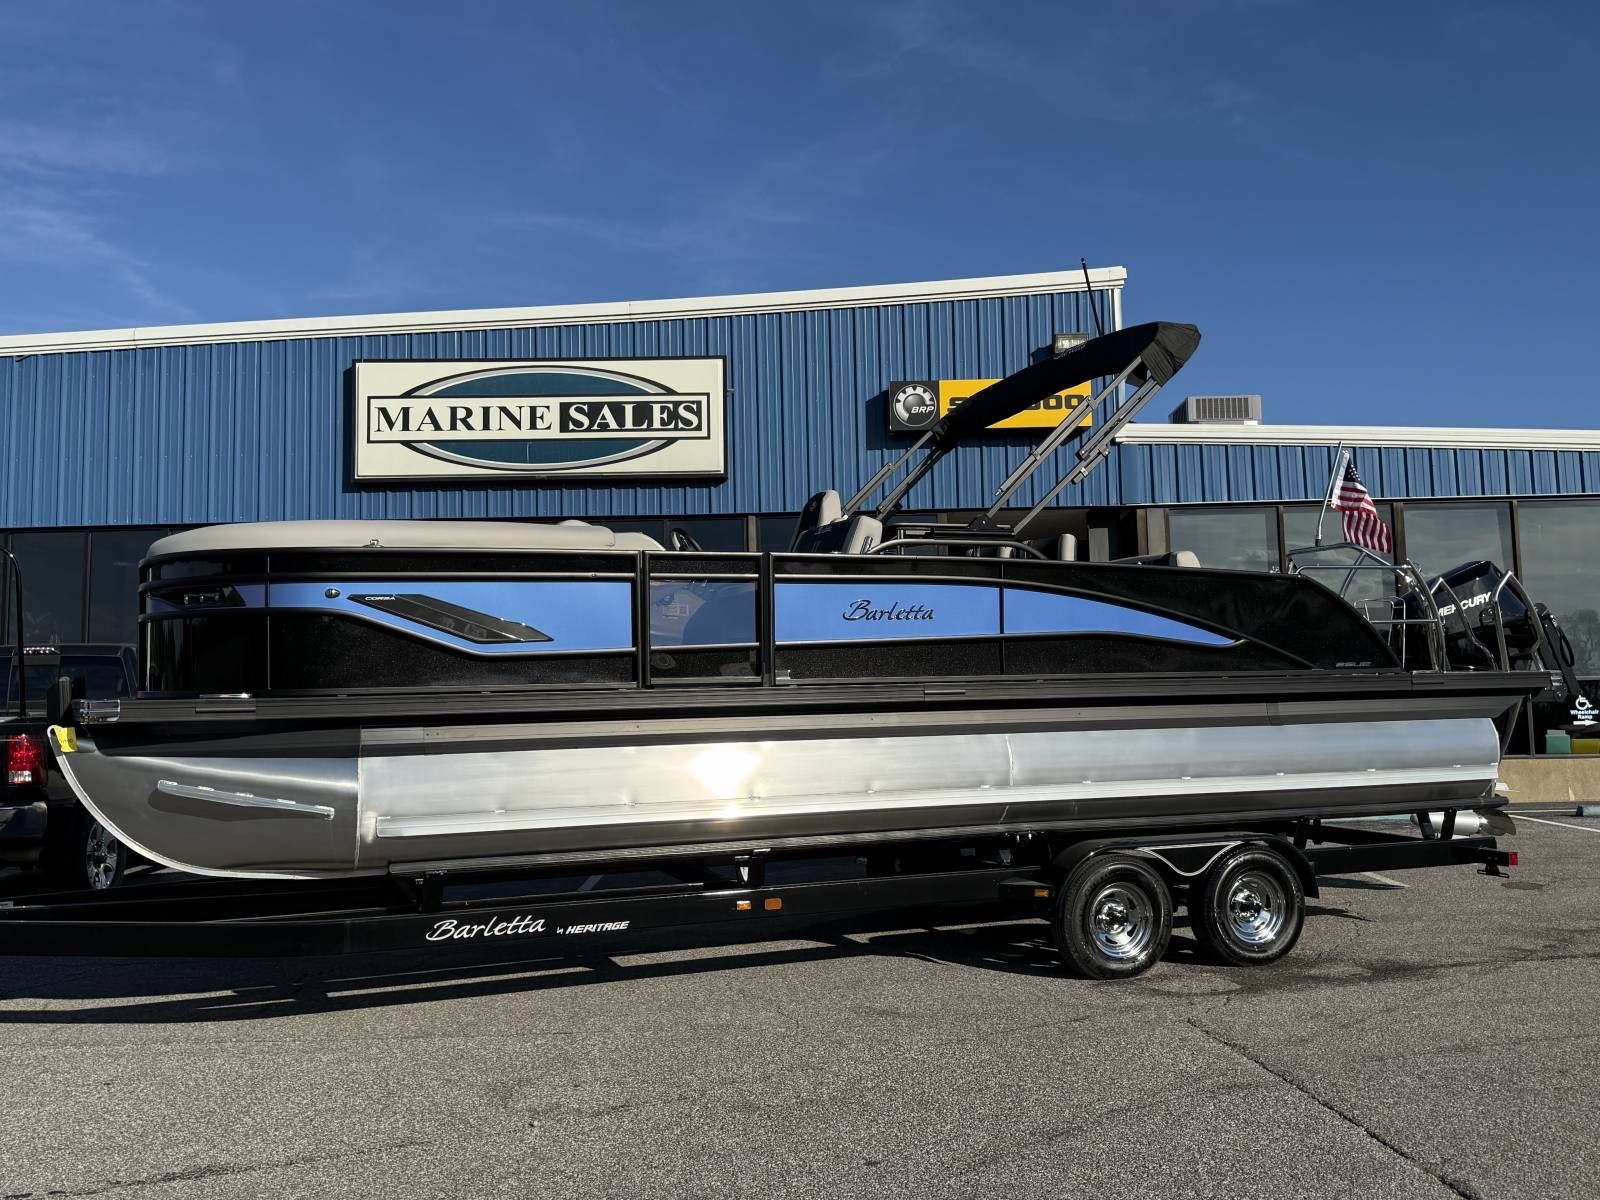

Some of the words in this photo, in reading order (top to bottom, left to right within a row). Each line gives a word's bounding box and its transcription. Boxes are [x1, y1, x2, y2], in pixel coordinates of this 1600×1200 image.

[373, 404, 553, 433] MARINE
[568, 402, 699, 431] SALES
[911, 405, 935, 414] BRP
[842, 599, 934, 621] Barletta
[425, 915, 546, 941] Barletta
[565, 921, 631, 934] HERITAGE
